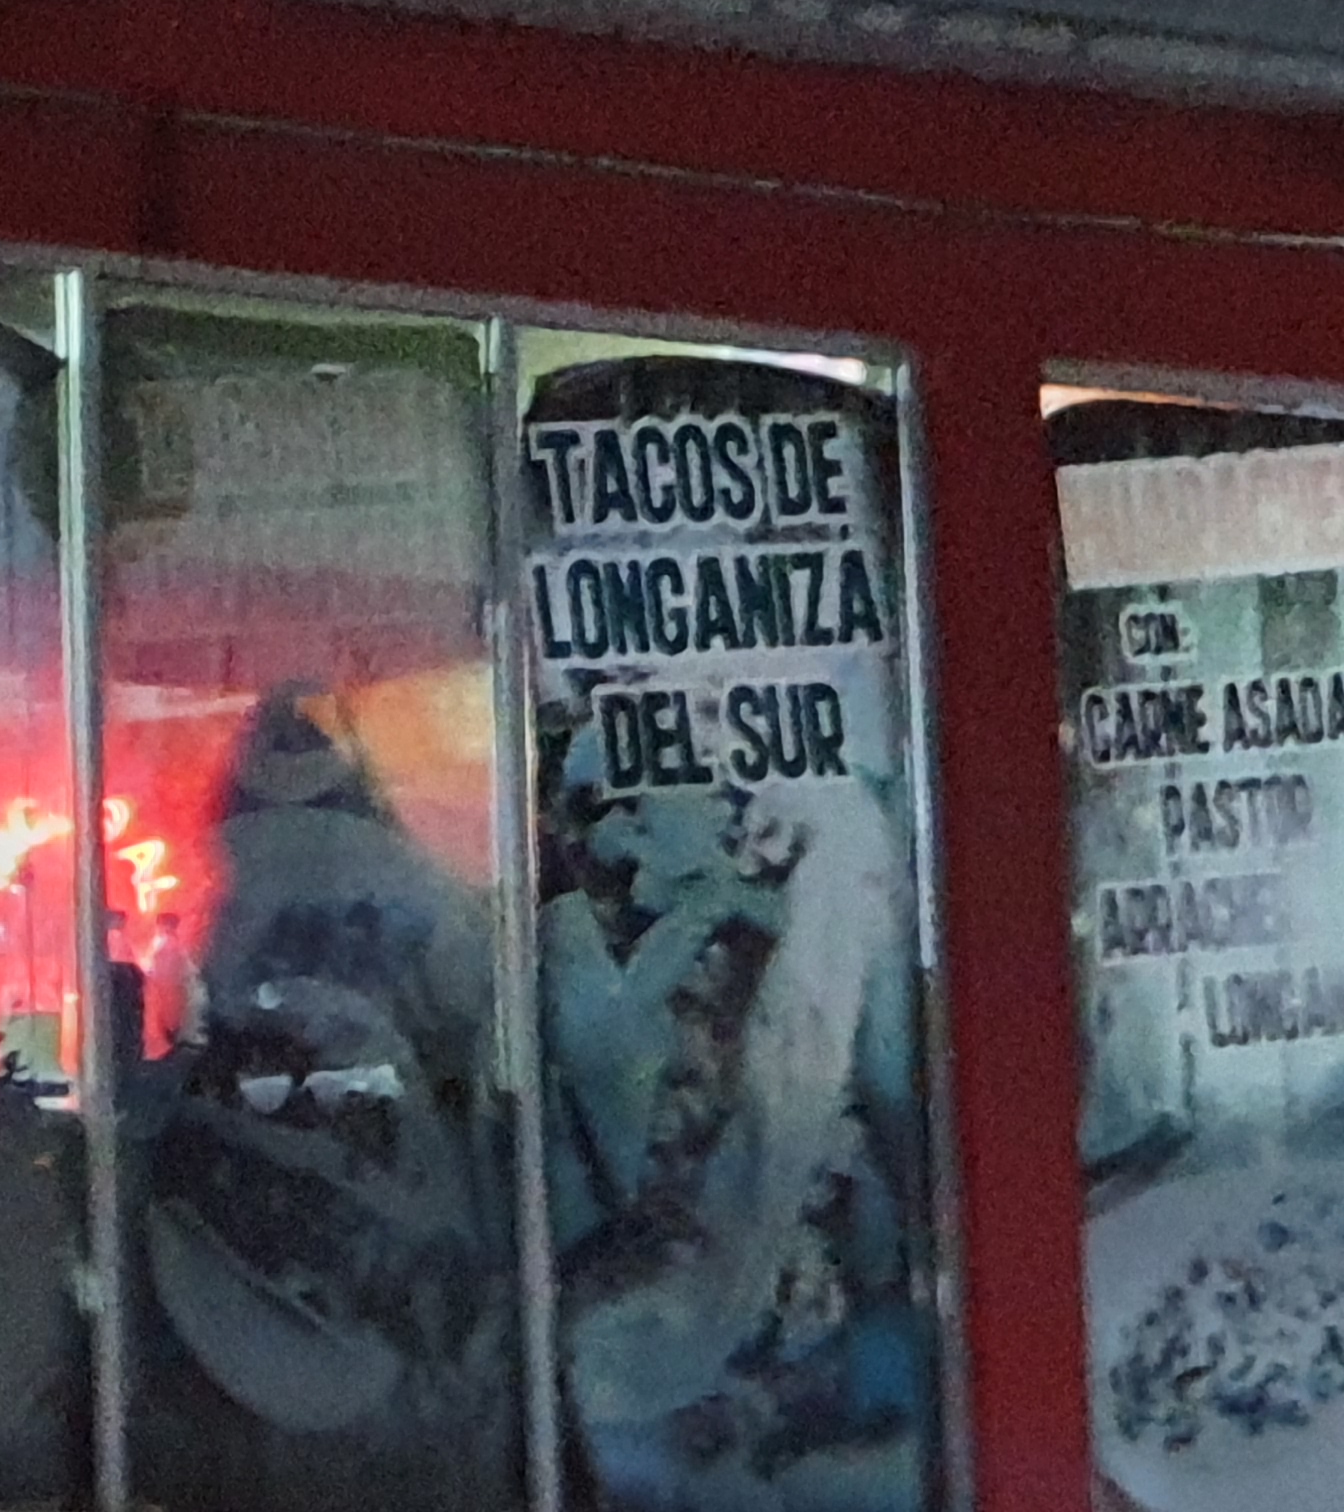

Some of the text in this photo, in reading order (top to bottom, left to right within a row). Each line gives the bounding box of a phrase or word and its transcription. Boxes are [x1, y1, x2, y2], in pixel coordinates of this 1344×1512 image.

[535, 420, 848, 524] TACOS DE
[532, 549, 884, 658] LONGANIZA
[599, 682, 848, 788] DEL SUR
[1083, 684, 1211, 764] CARNE
